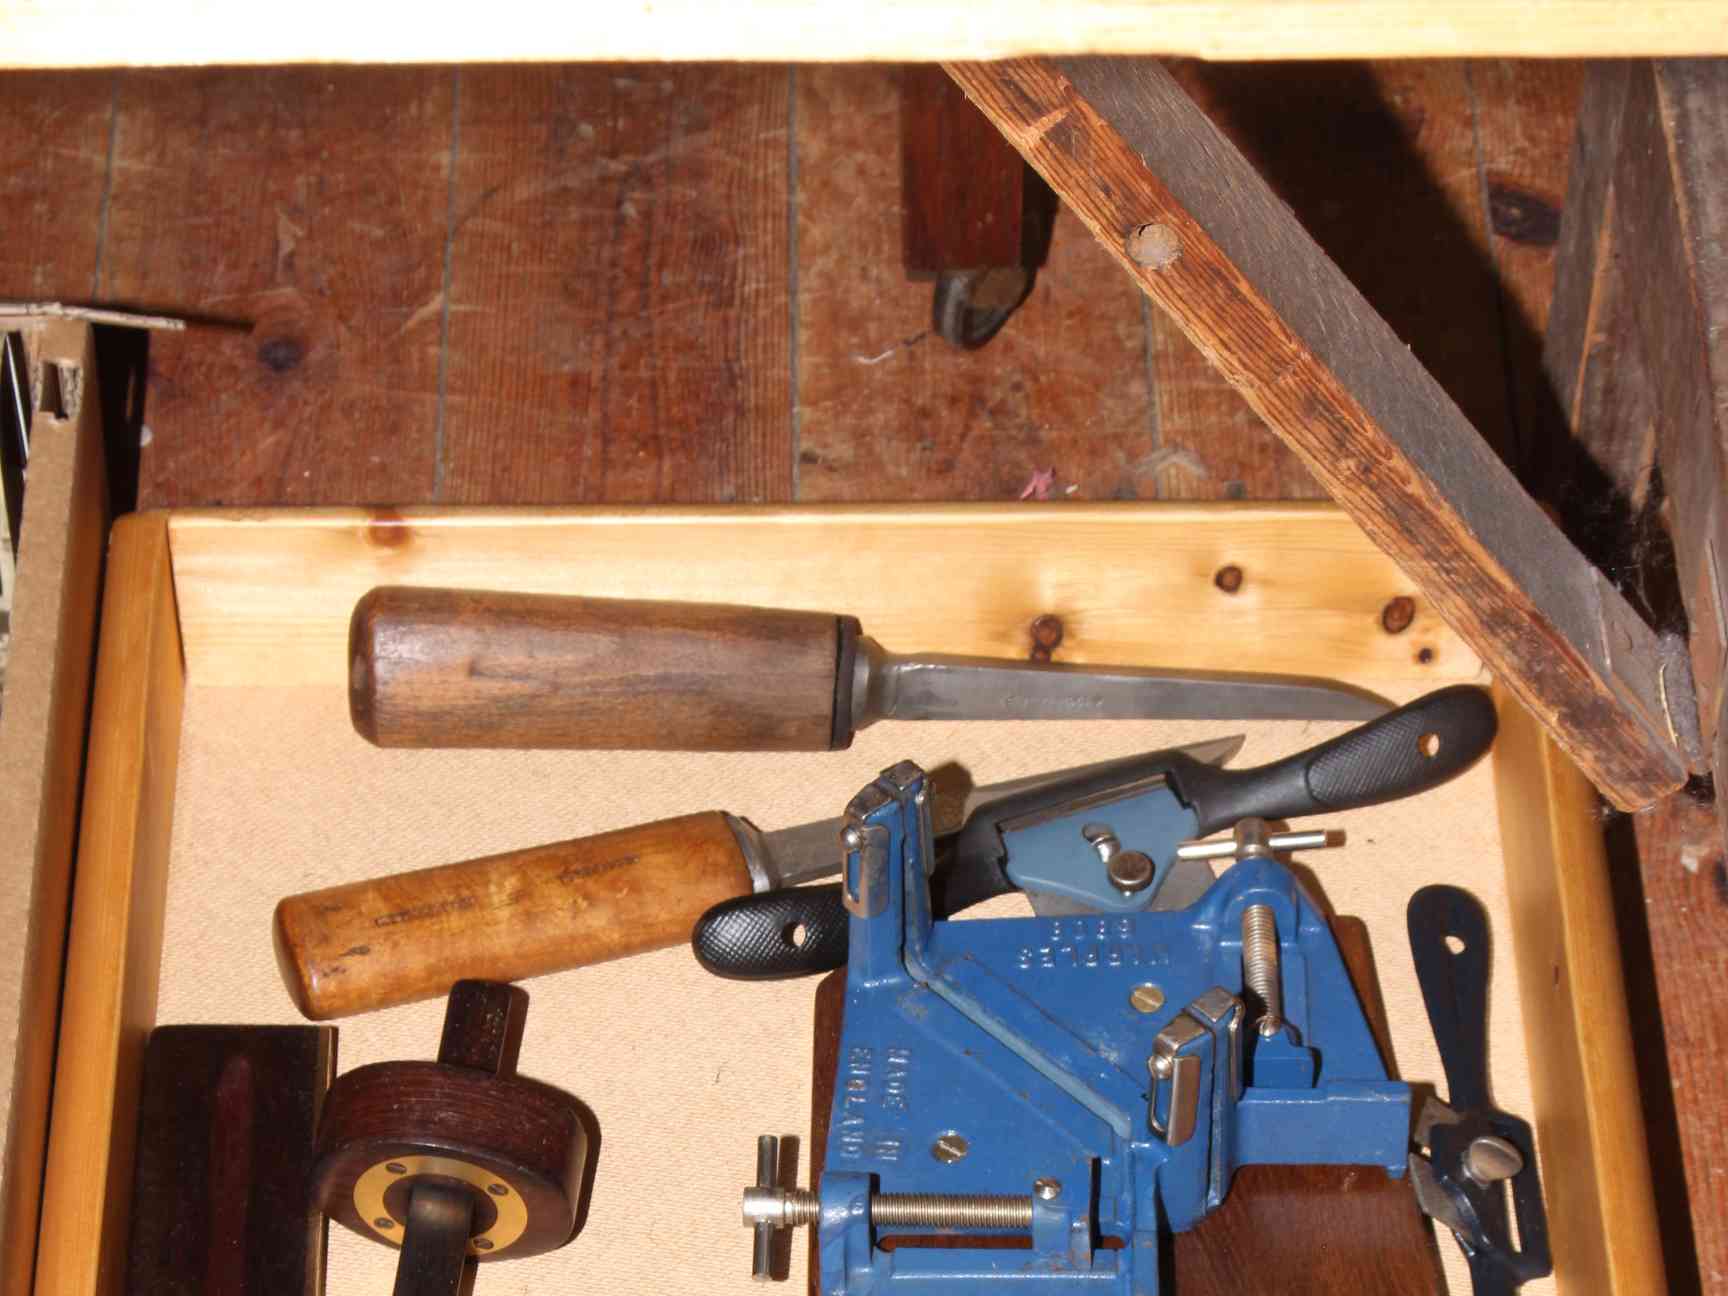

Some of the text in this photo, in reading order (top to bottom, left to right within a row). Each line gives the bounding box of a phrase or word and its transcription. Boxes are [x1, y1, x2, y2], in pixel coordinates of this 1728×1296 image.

[837, 1047, 873, 1160] ENGLAND
[877, 1048, 911, 1161] MADE IN
